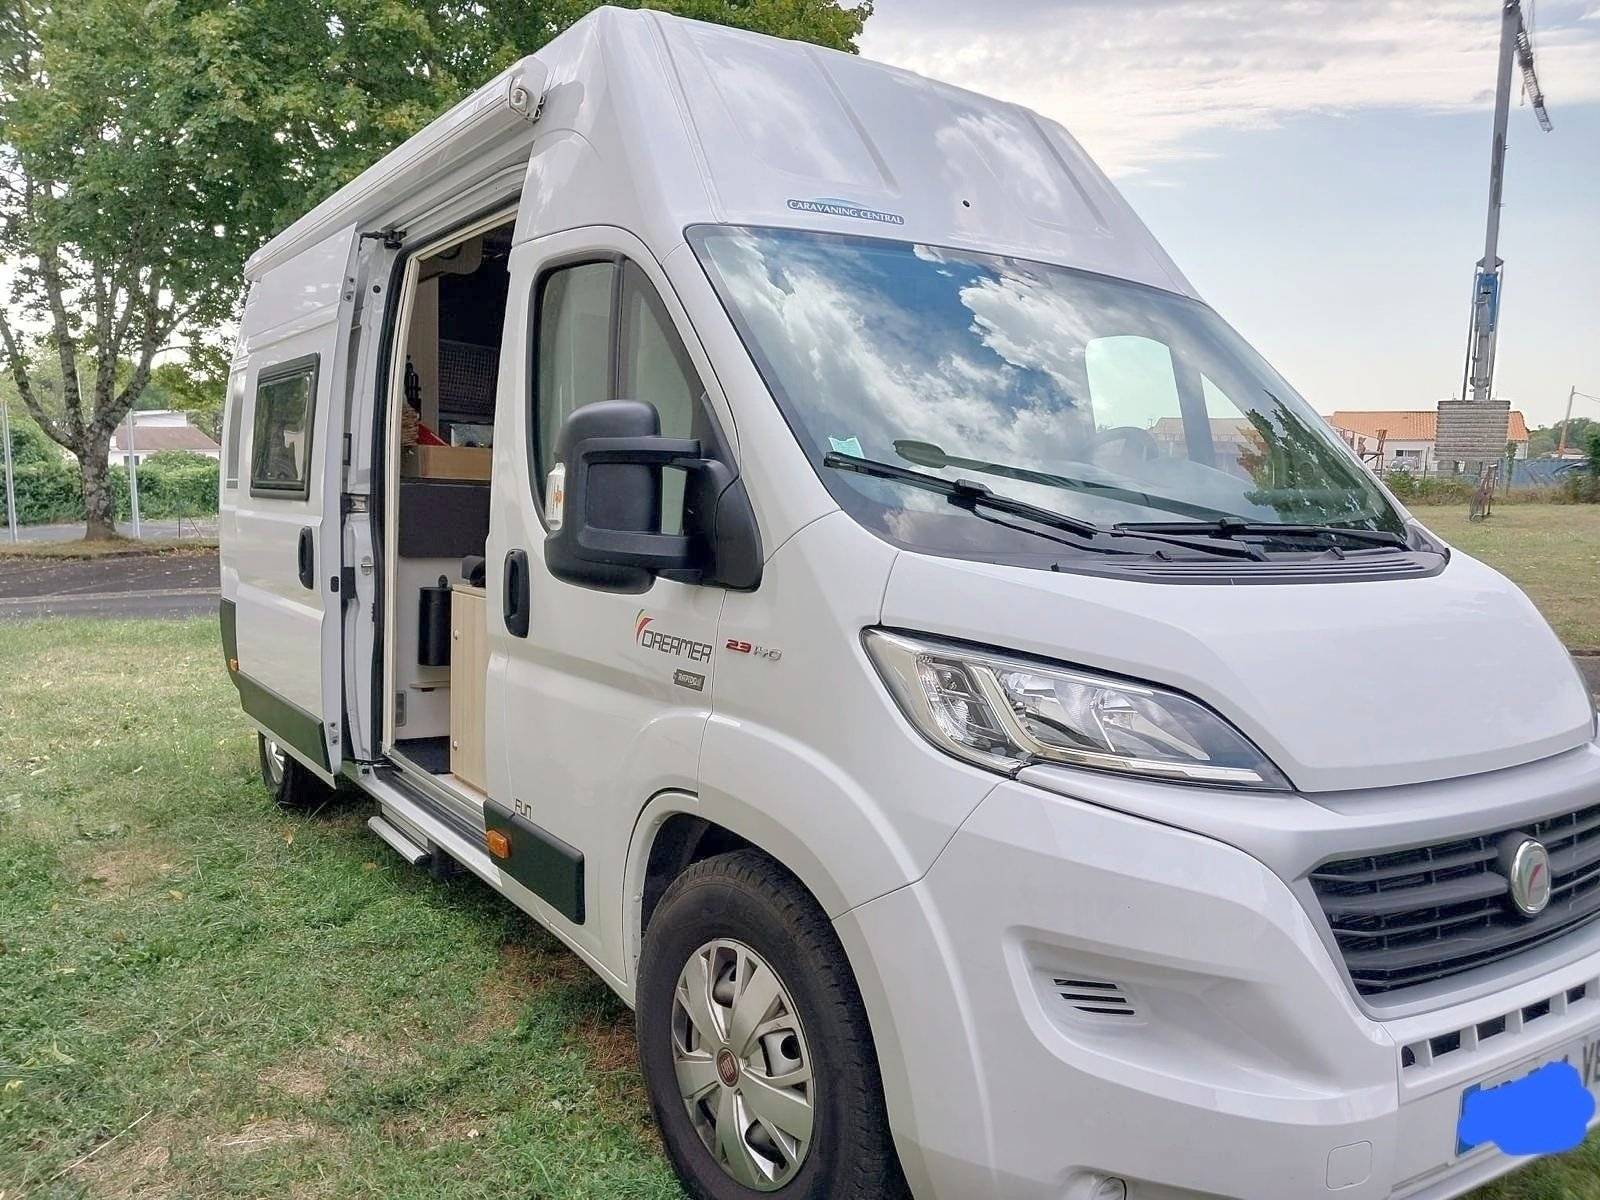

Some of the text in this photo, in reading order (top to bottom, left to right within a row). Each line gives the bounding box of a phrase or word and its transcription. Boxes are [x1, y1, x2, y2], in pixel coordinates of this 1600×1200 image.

[789, 200, 903, 224] CARAVANING CENTRAL
[641, 629, 713, 664] DREAMER
